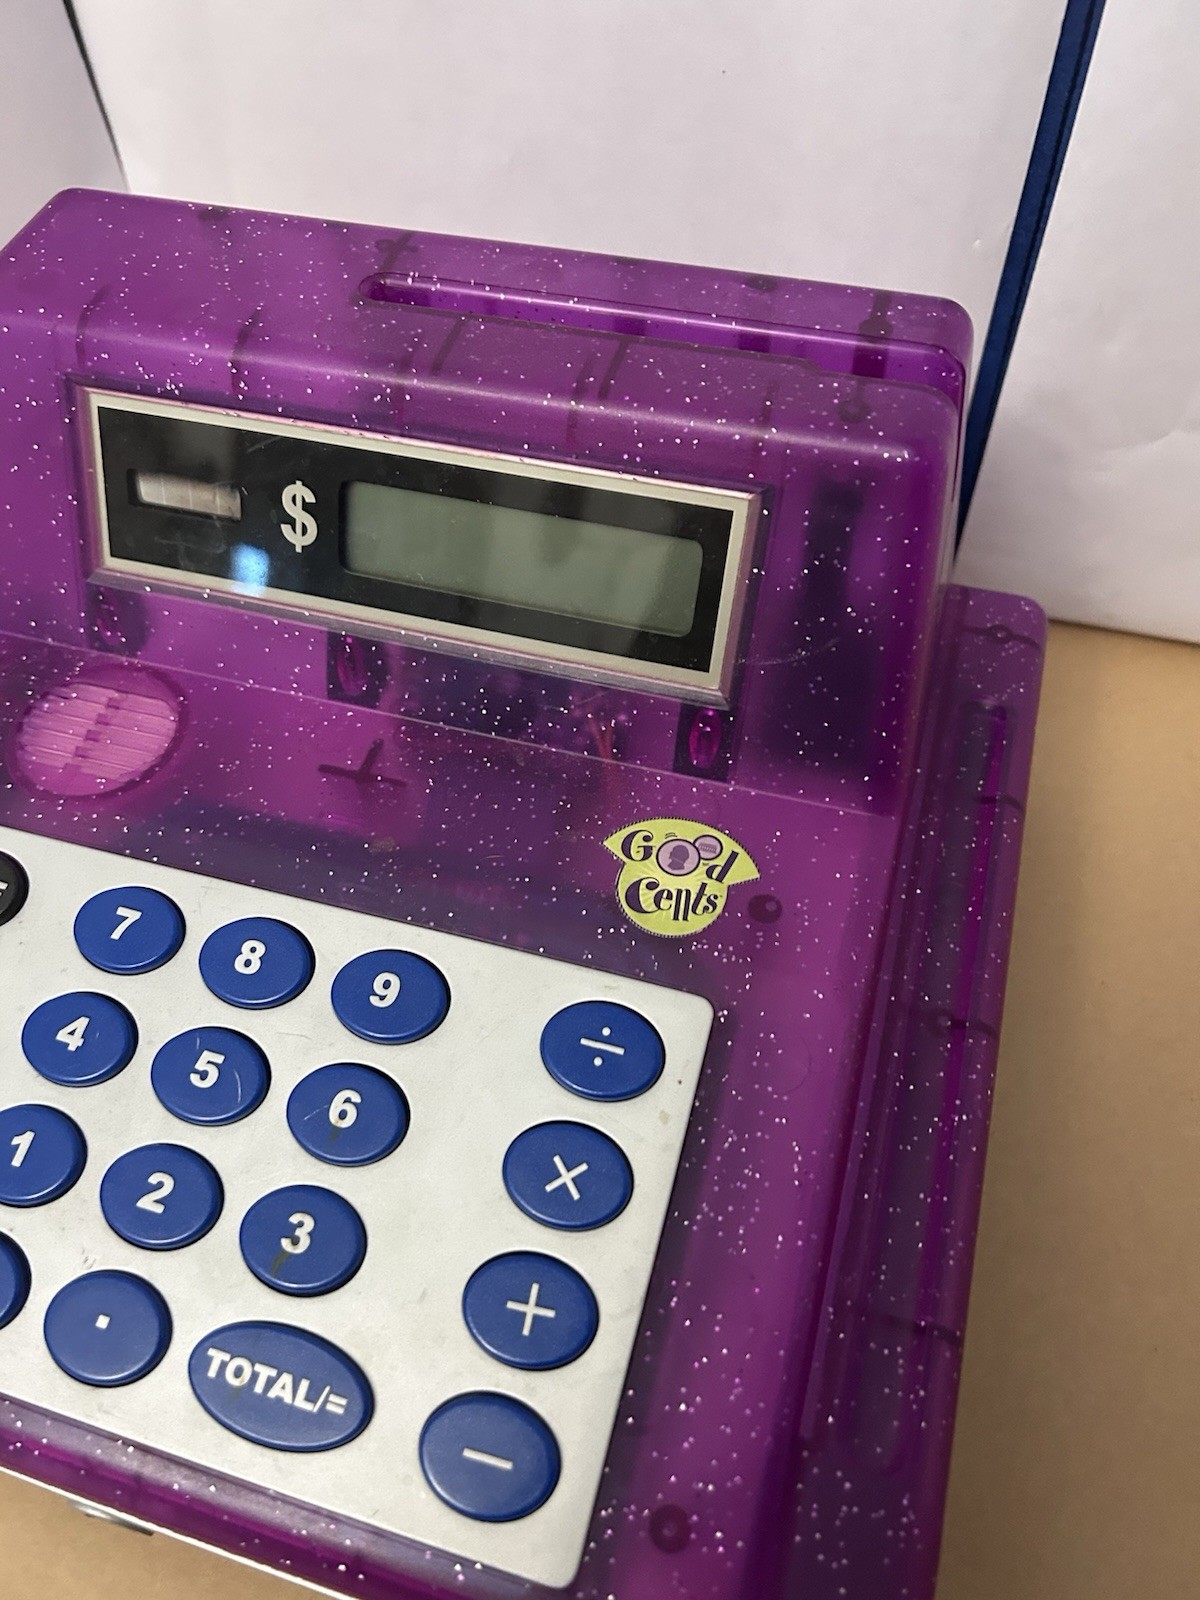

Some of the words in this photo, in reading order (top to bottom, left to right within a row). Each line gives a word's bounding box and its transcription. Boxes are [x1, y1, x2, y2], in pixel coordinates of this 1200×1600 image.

[281, 481, 317, 552] $
[621, 829, 740, 884] Good
[624, 876, 720, 922] Cents
[111, 907, 142, 939] 7
[235, 940, 265, 974] 8
[370, 973, 400, 1007] 9
[56, 1017, 89, 1051] 4
[190, 1050, 225, 1088] 5
[329, 1090, 361, 1128] 6
[11, 1131, 34, 1167] 1
[136, 1173, 174, 1213] 2
[281, 1213, 314, 1254] 3
[506, 1283, 555, 1336] +
[206, 1347, 348, 1415] TOTAL/=
